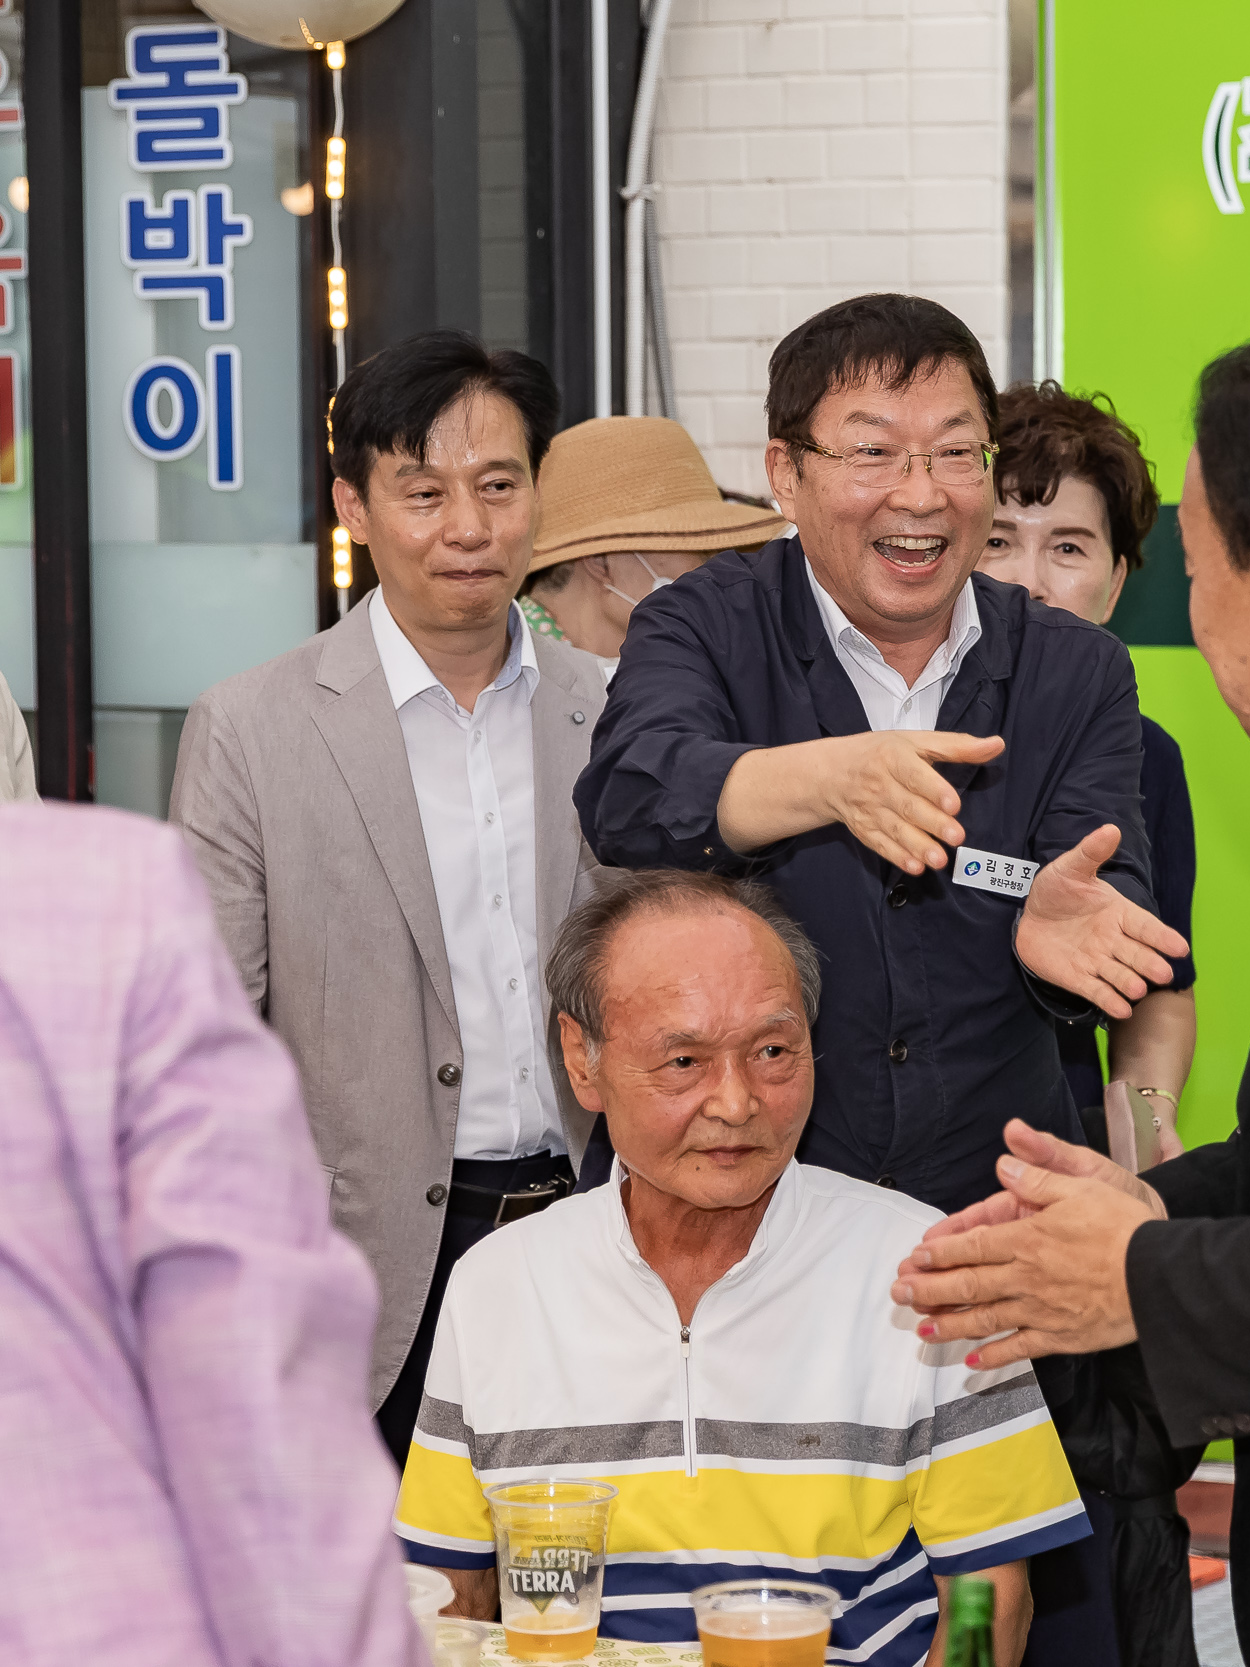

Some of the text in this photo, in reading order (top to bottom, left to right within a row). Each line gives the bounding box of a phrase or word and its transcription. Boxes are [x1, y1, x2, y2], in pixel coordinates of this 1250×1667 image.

[109, 24, 252, 490] 돌박이
[989, 876, 1024, 891] 광진구청장
[508, 1567, 575, 1593] TERRA
